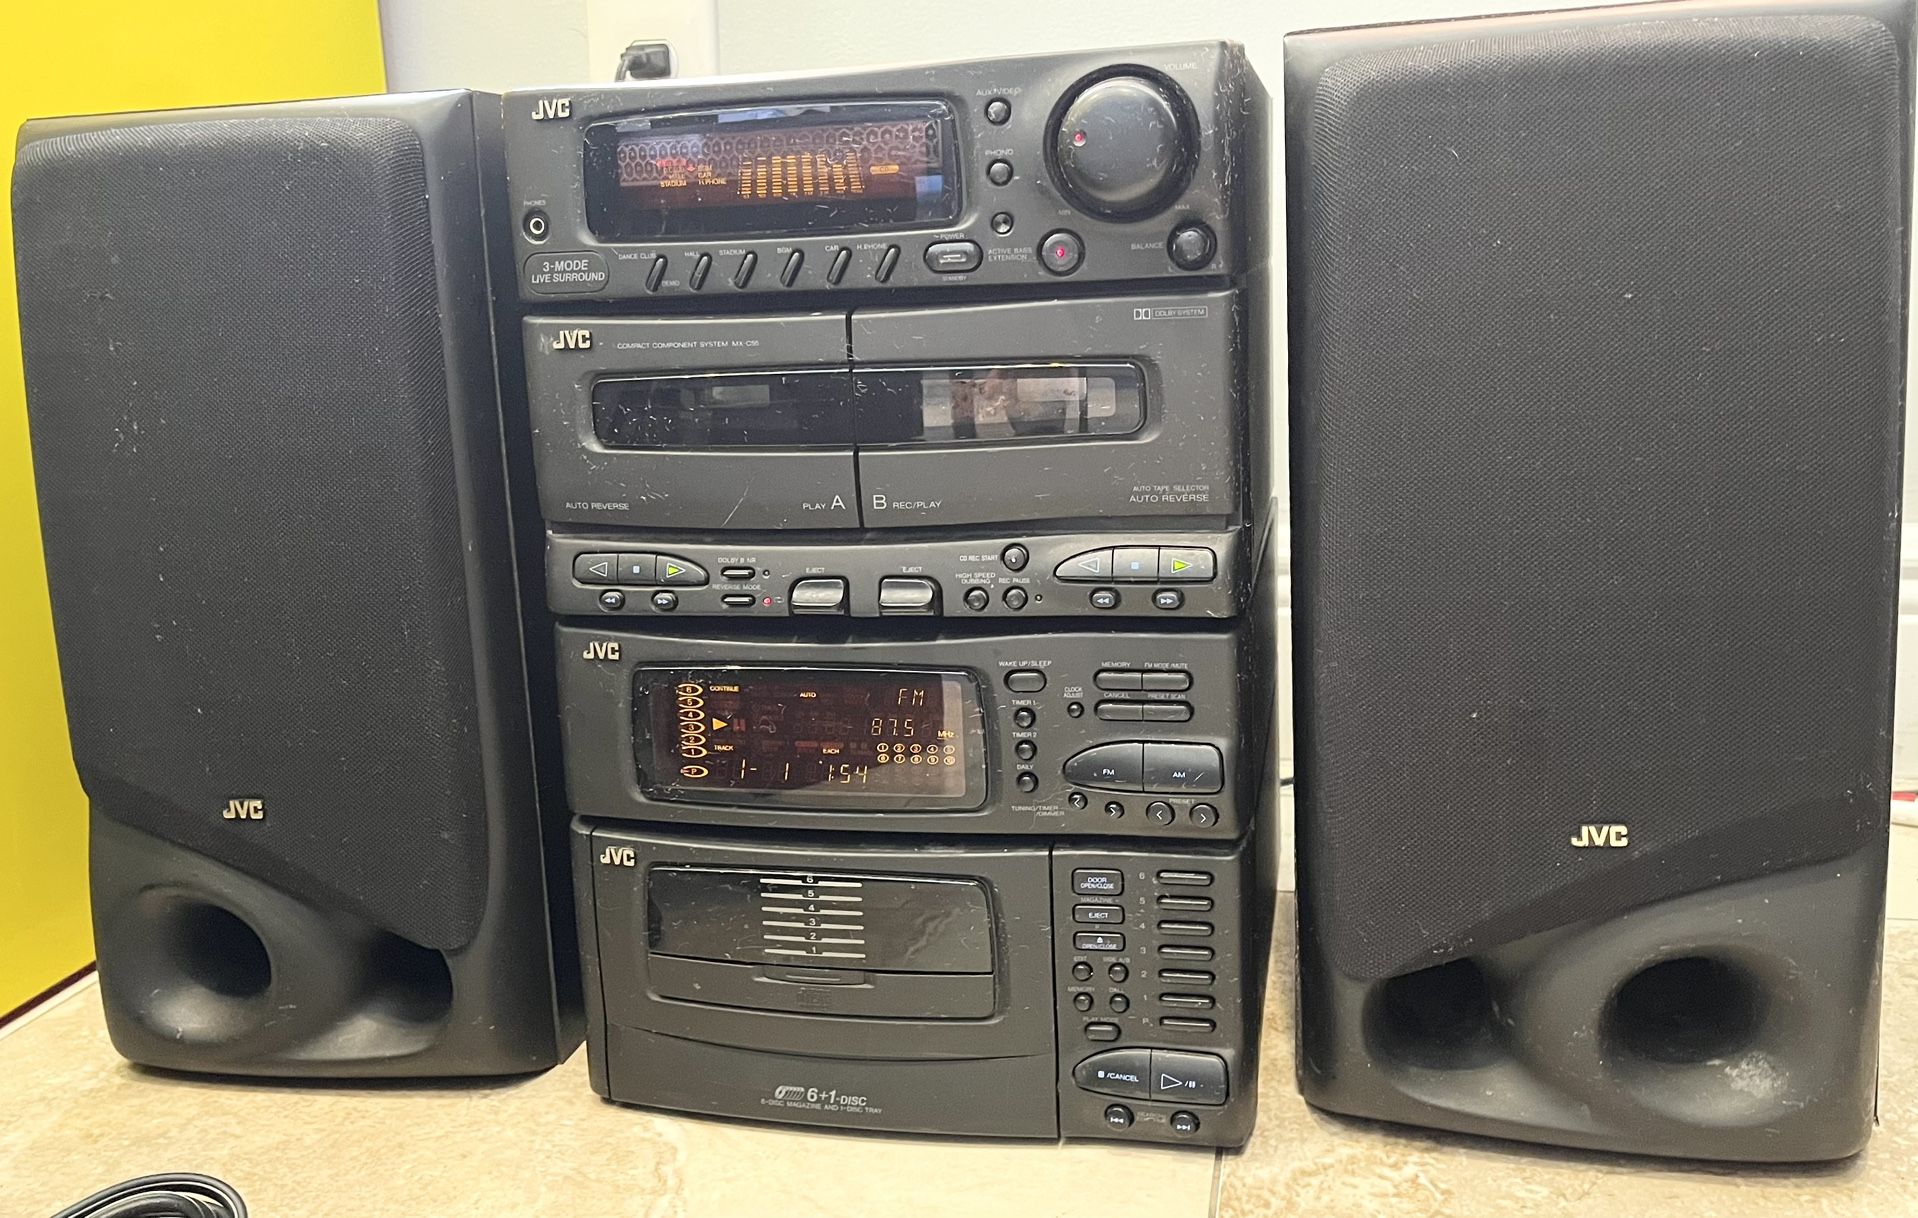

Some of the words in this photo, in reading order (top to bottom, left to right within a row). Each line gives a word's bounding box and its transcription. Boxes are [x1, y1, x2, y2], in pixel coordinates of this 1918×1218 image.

[1164, 62, 1197, 71] VOLUME
[531, 98, 571, 120] JVC
[825, 244, 839, 252] CAR
[1131, 242, 1164, 250] BALANCE
[719, 248, 746, 256] STADIUM
[618, 253, 638, 261] DANCE
[543, 259, 589, 272] 3-MODE
[531, 273, 551, 284] LIVE
[552, 271, 606, 283] SURROUND
[552, 330, 591, 349] JVC
[652, 341, 697, 349] COMPONENT
[802, 502, 826, 510] PLAY
[831, 494, 846, 510] A
[873, 494, 887, 510] B
[893, 500, 942, 509] REC/PLAY
[1129, 495, 1159, 503] AUTO
[1162, 494, 1209, 502] REVERSE
[565, 502, 589, 510] AUTO
[591, 502, 630, 510] REVERSE
[582, 641, 620, 660] JVC
[898, 688, 924, 706] FM
[870, 718, 914, 736] 87.5
[828, 764, 868, 783] 1:54
[1102, 768, 1115, 776] FM
[222, 799, 264, 820] JVC
[1570, 824, 1629, 847] JVC
[600, 846, 635, 866] JVC
[806, 875, 814, 884] 6
[807, 890, 815, 898] 5
[1139, 897, 1145, 905] 5
[808, 904, 815, 912] 4
[809, 918, 816, 926] 3
[810, 932, 817, 940] 2
[787, 1101, 821, 1110] MAGAZINE
